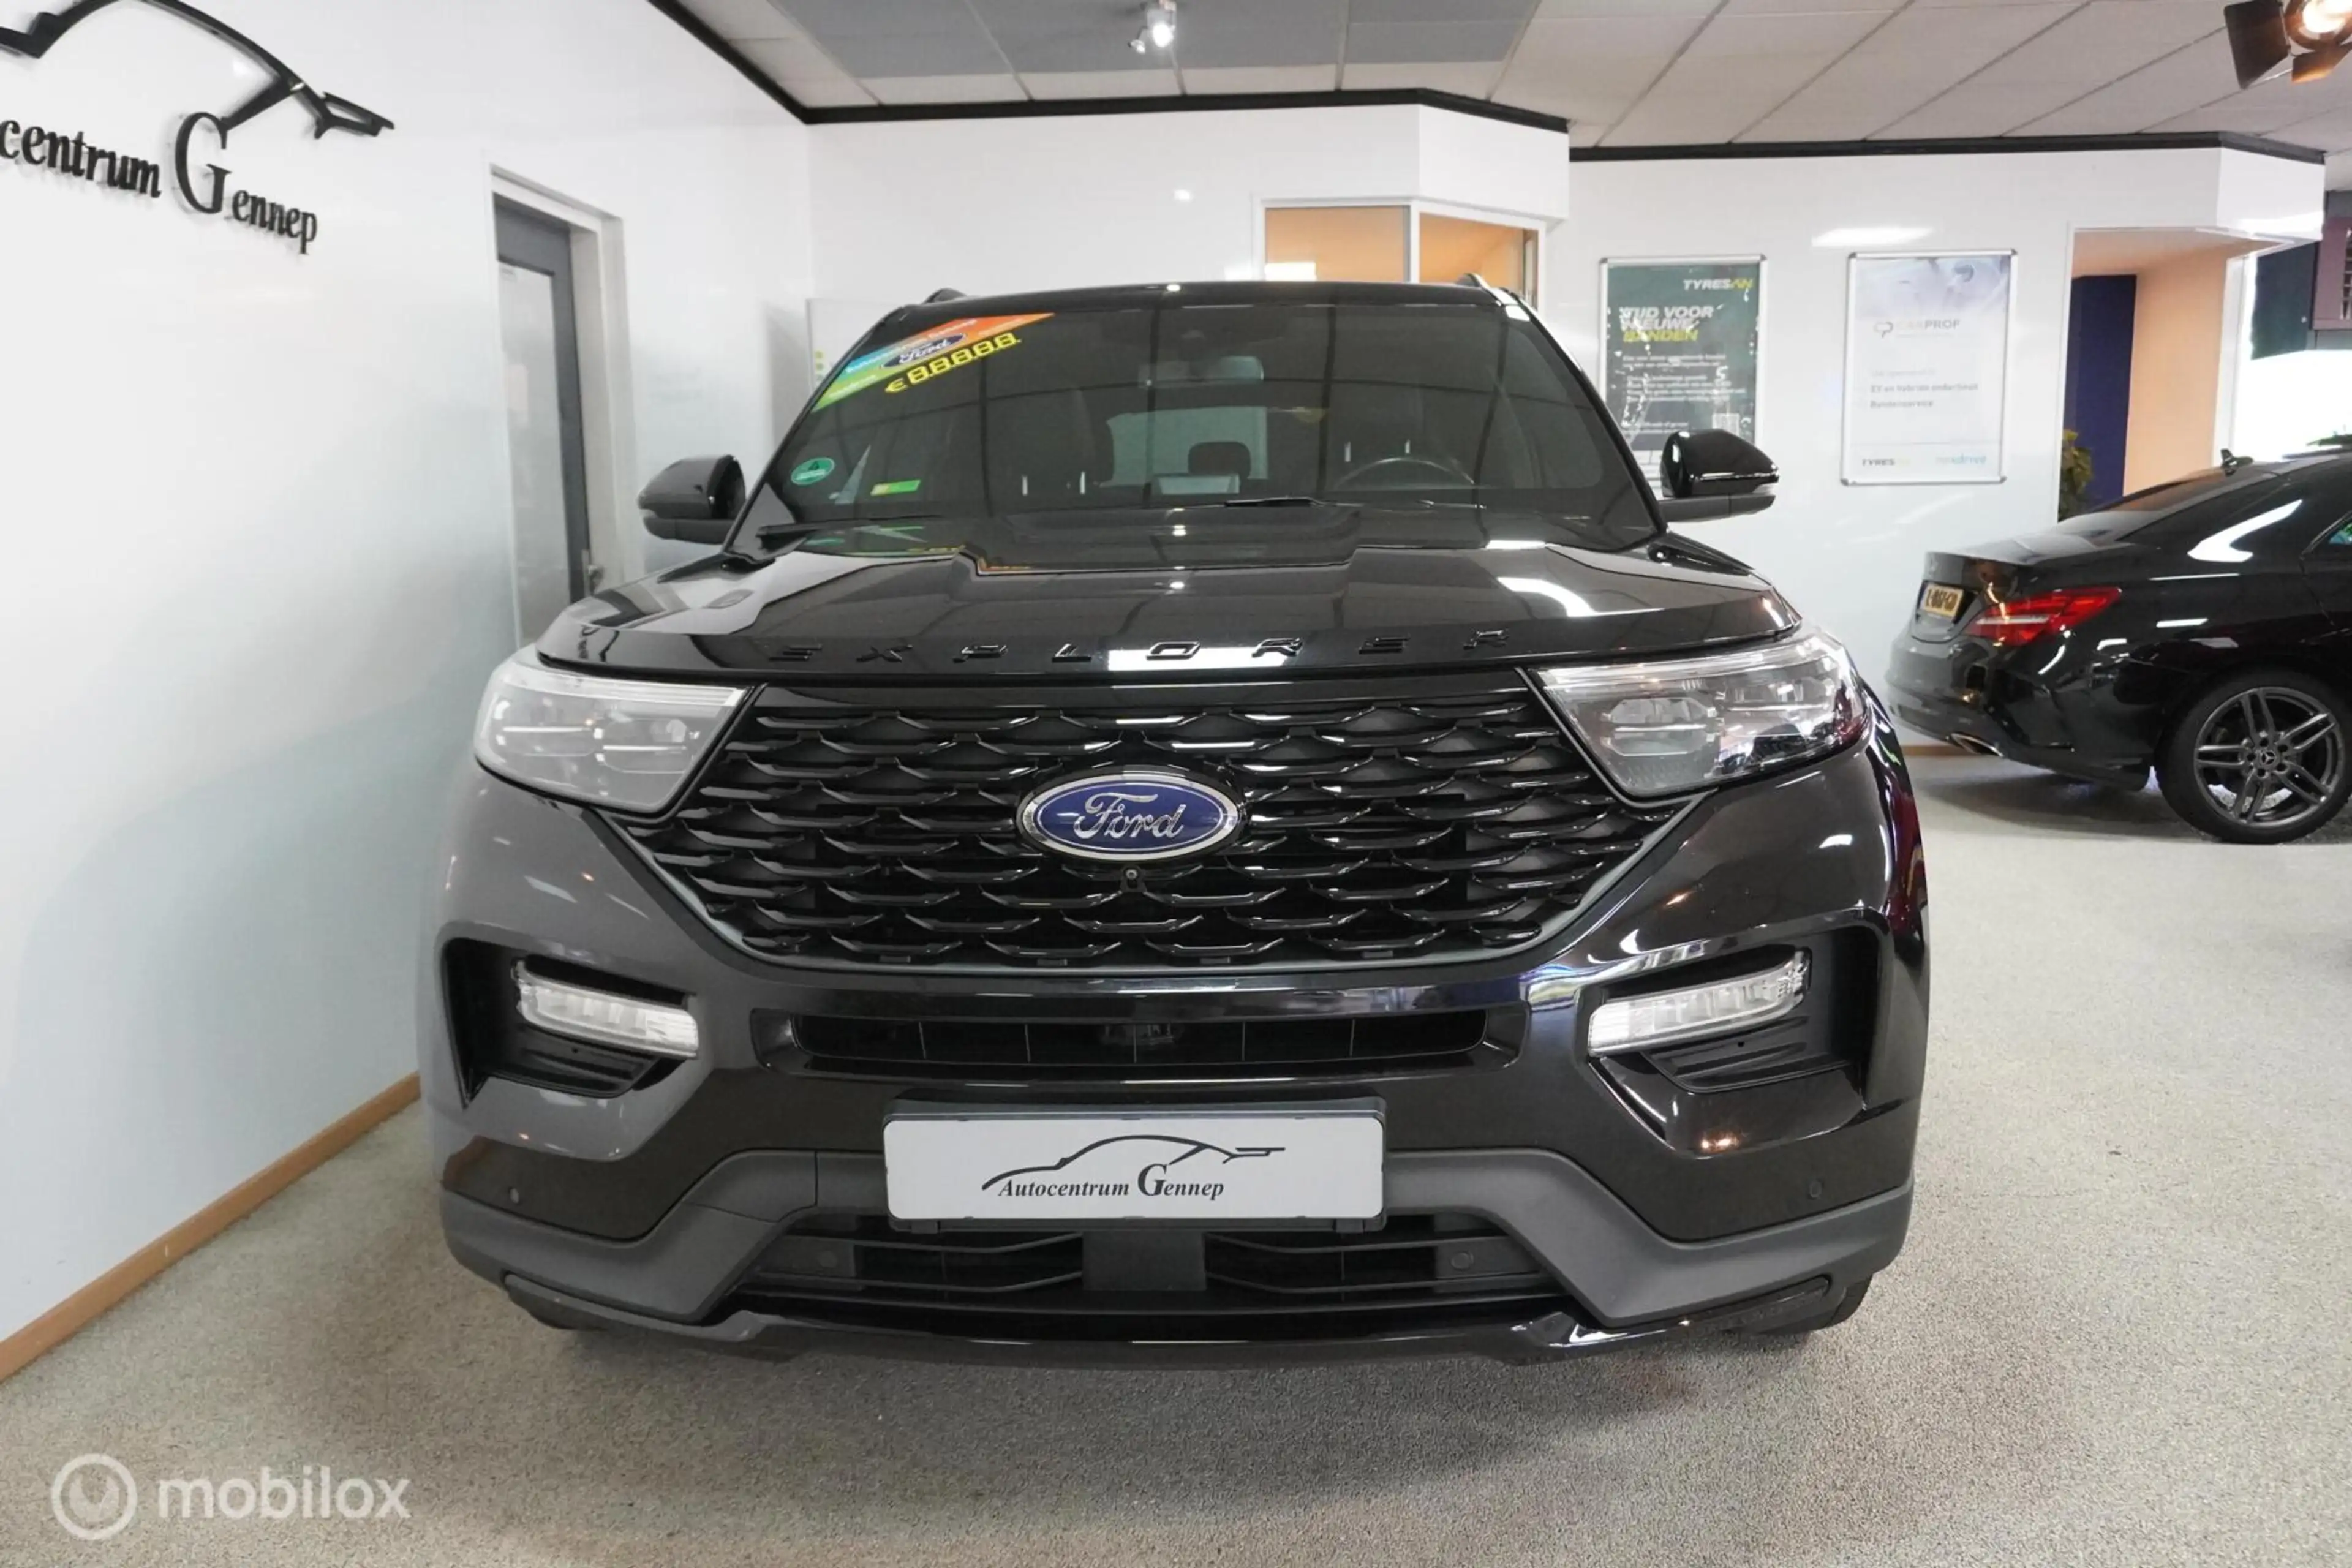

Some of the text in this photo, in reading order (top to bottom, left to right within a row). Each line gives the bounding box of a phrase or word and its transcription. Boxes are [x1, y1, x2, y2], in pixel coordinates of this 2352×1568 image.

[175, 111, 317, 255] Gennep
[1664, 306, 1714, 318] VOOR
[899, 339, 951, 363] Ford
[768, 627, 1509, 663] EXPLORER
[1073, 792, 1186, 839] Ford
[998, 1164, 1224, 1200] Autocentrum Gennep
